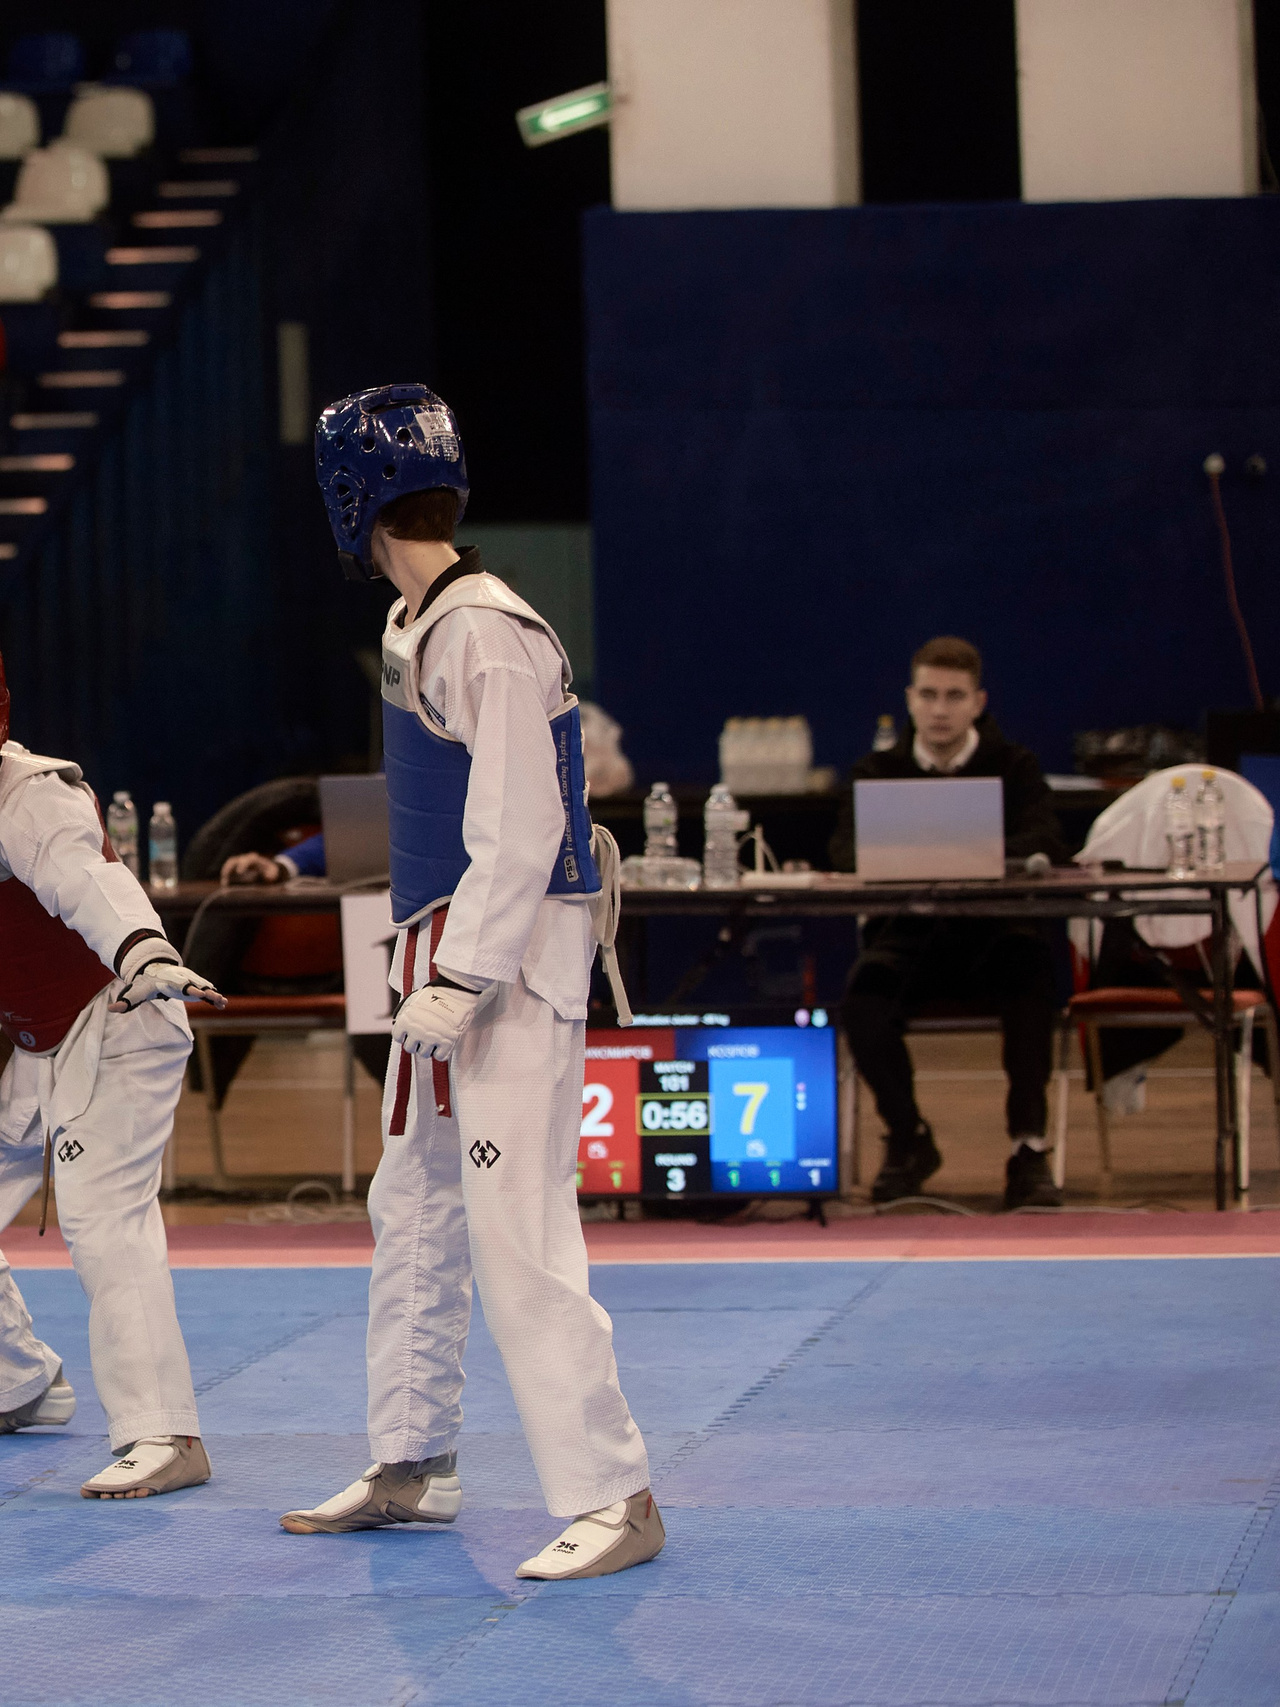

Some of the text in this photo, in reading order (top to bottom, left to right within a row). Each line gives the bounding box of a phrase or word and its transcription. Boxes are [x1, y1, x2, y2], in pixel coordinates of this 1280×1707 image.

[381, 661, 401, 687] NP
[559, 731, 568, 762] System
[561, 766, 569, 797] Scoring
[566, 858, 575, 879] PSS
[653, 1061, 696, 1074] MATCH
[580, 1083, 614, 1137] 2
[642, 1101, 708, 1130] 0:56
[733, 1082, 769, 1135] 7
[654, 1153, 697, 1167] ROUND
[611, 1171, 622, 1189] 1
[666, 1168, 686, 1192] 3
[728, 1169, 740, 1188] 1
[769, 1169, 781, 1187] 1
[808, 1168, 821, 1187] 1
